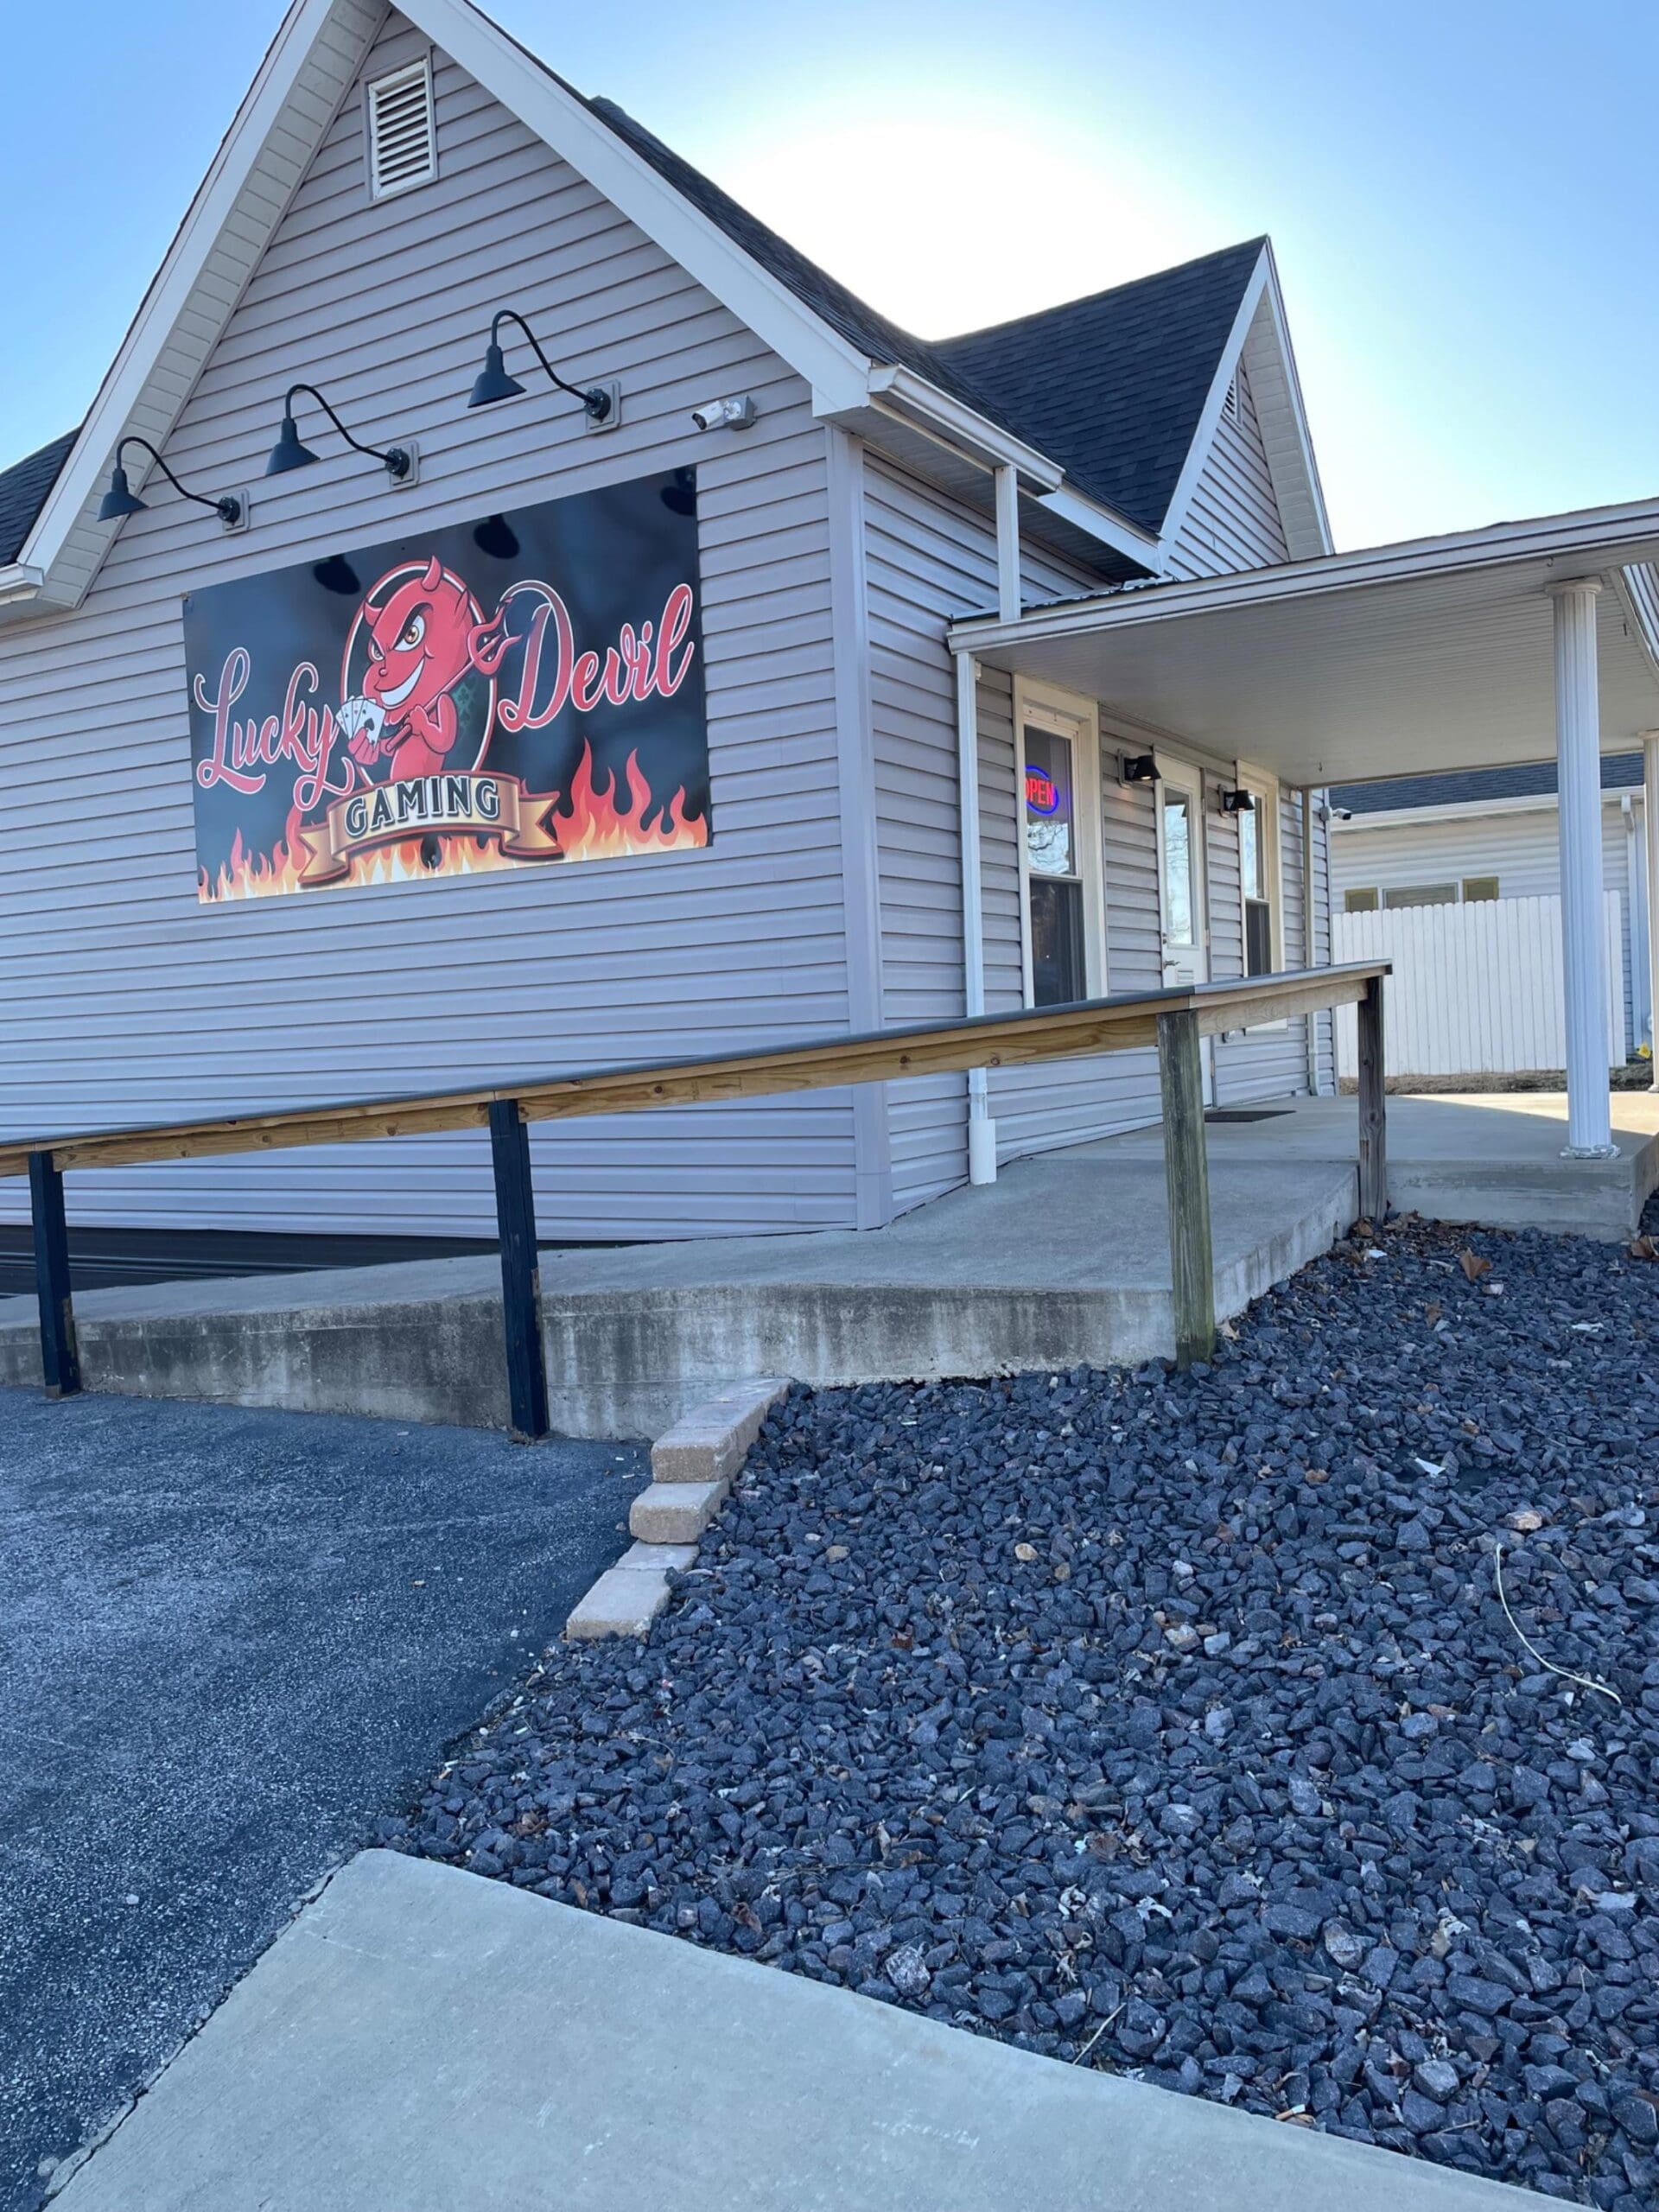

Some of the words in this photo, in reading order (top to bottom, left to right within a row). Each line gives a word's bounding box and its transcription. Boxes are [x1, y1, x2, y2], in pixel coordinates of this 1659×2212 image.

[194, 647, 354, 810] Lucky
[498, 580, 695, 733] Devil
[346, 776, 499, 836] GAMING
[1024, 778, 1054, 805] OPEN
